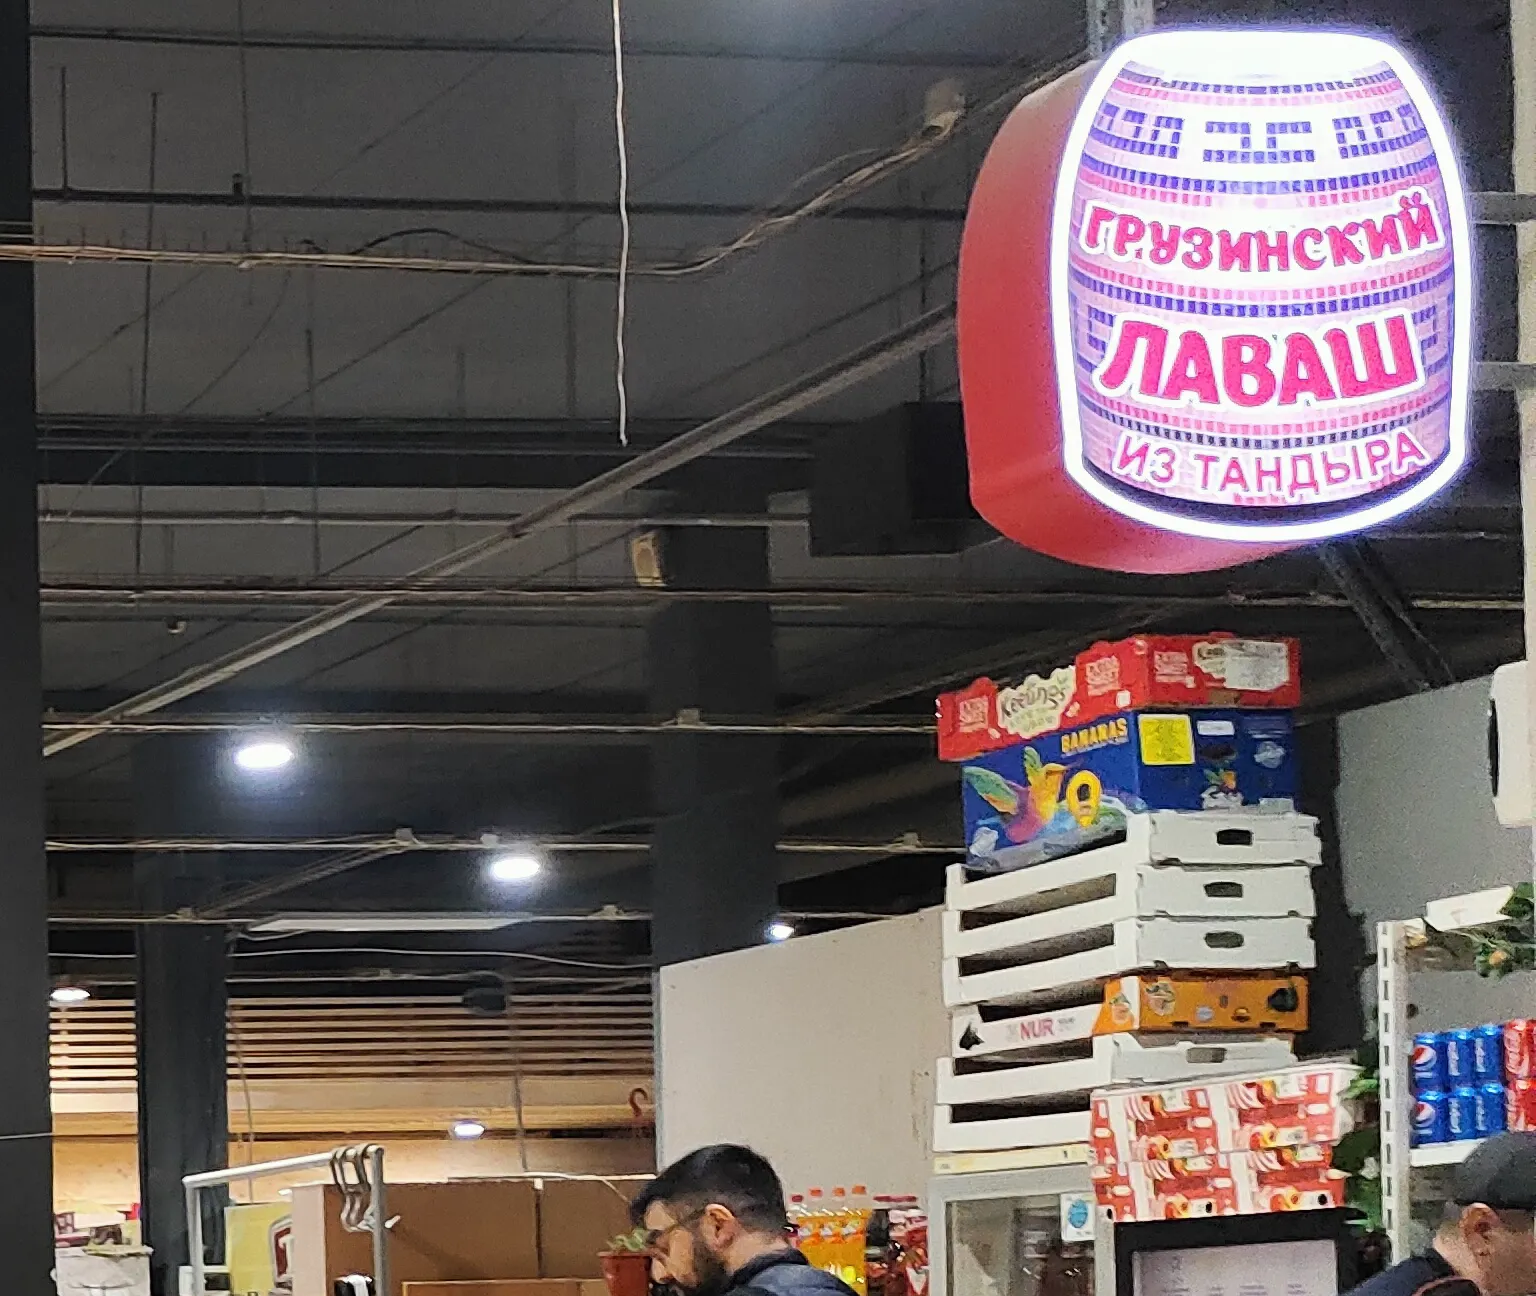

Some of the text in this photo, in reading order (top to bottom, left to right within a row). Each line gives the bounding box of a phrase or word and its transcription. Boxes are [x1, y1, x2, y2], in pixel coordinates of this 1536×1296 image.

[1086, 191, 1439, 272] ГРУЗИНСКИЙ
[1100, 315, 1418, 407] ЛАВАШ
[1115, 431, 1426, 497] ИЗ ТАНДЫРА
[1019, 1018, 1056, 1039] NUR
